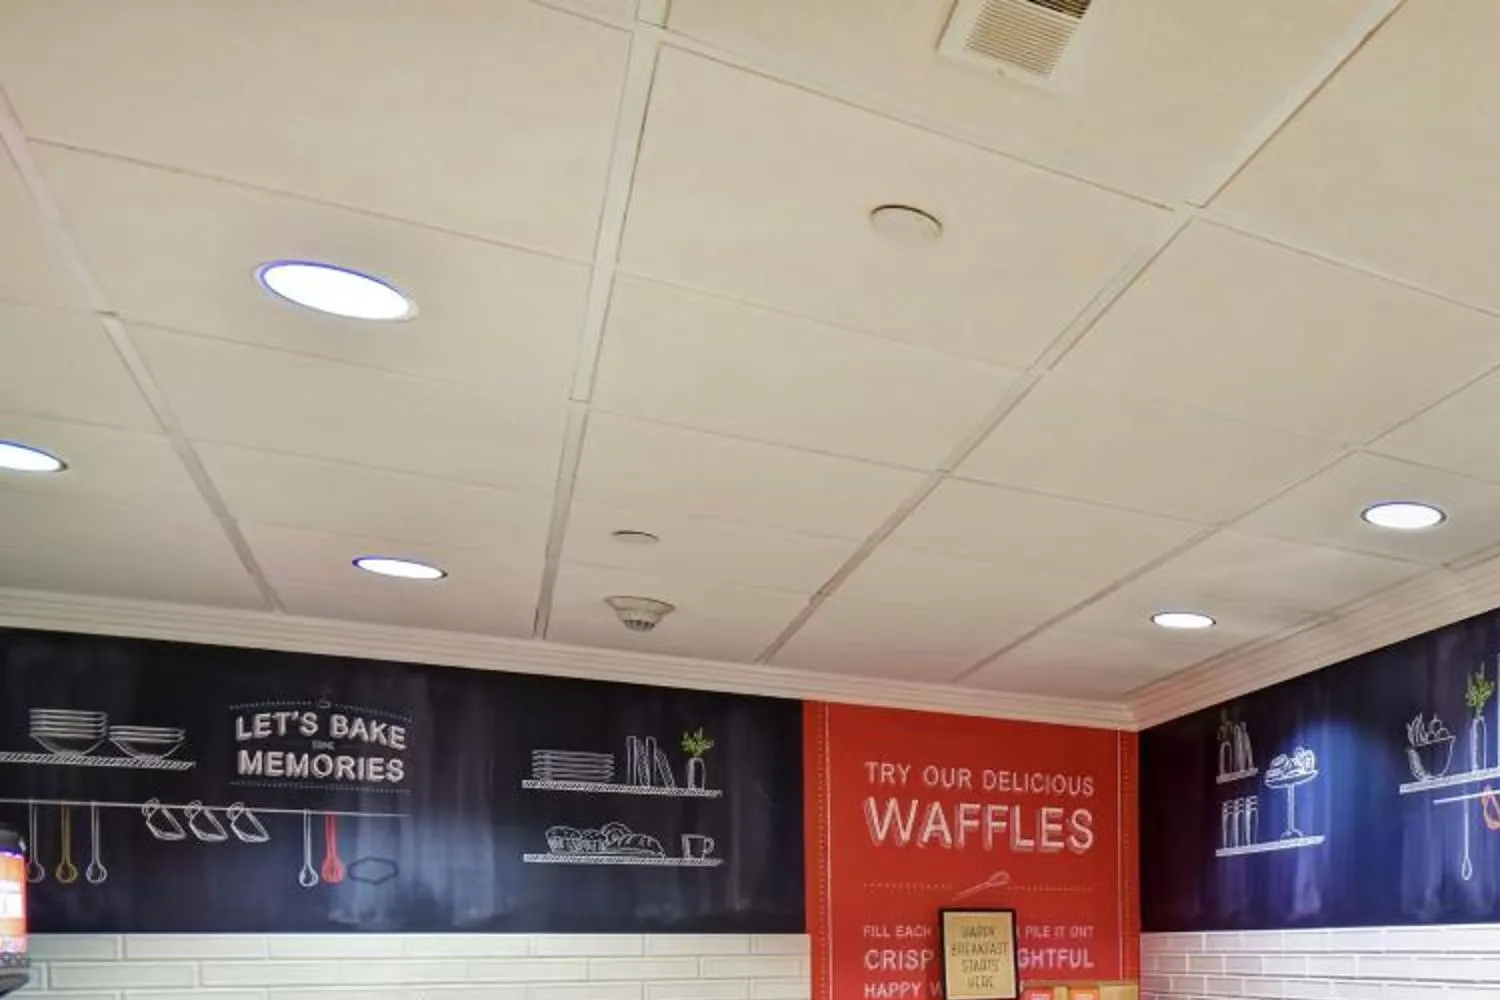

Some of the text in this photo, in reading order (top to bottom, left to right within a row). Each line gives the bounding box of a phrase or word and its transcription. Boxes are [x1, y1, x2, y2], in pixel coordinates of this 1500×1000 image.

[235, 711, 407, 750] LET'S BAKE
[237, 750, 405, 782] MEMORIES
[865, 761, 1094, 797] TRY OUR DELICIOUS
[864, 797, 1095, 852] WAFFLES
[863, 925, 890, 938] FILL
[895, 925, 932, 938] EACH
[864, 948, 1095, 971] CRISP GHTFUL
[864, 981, 921, 999] HAPPY
